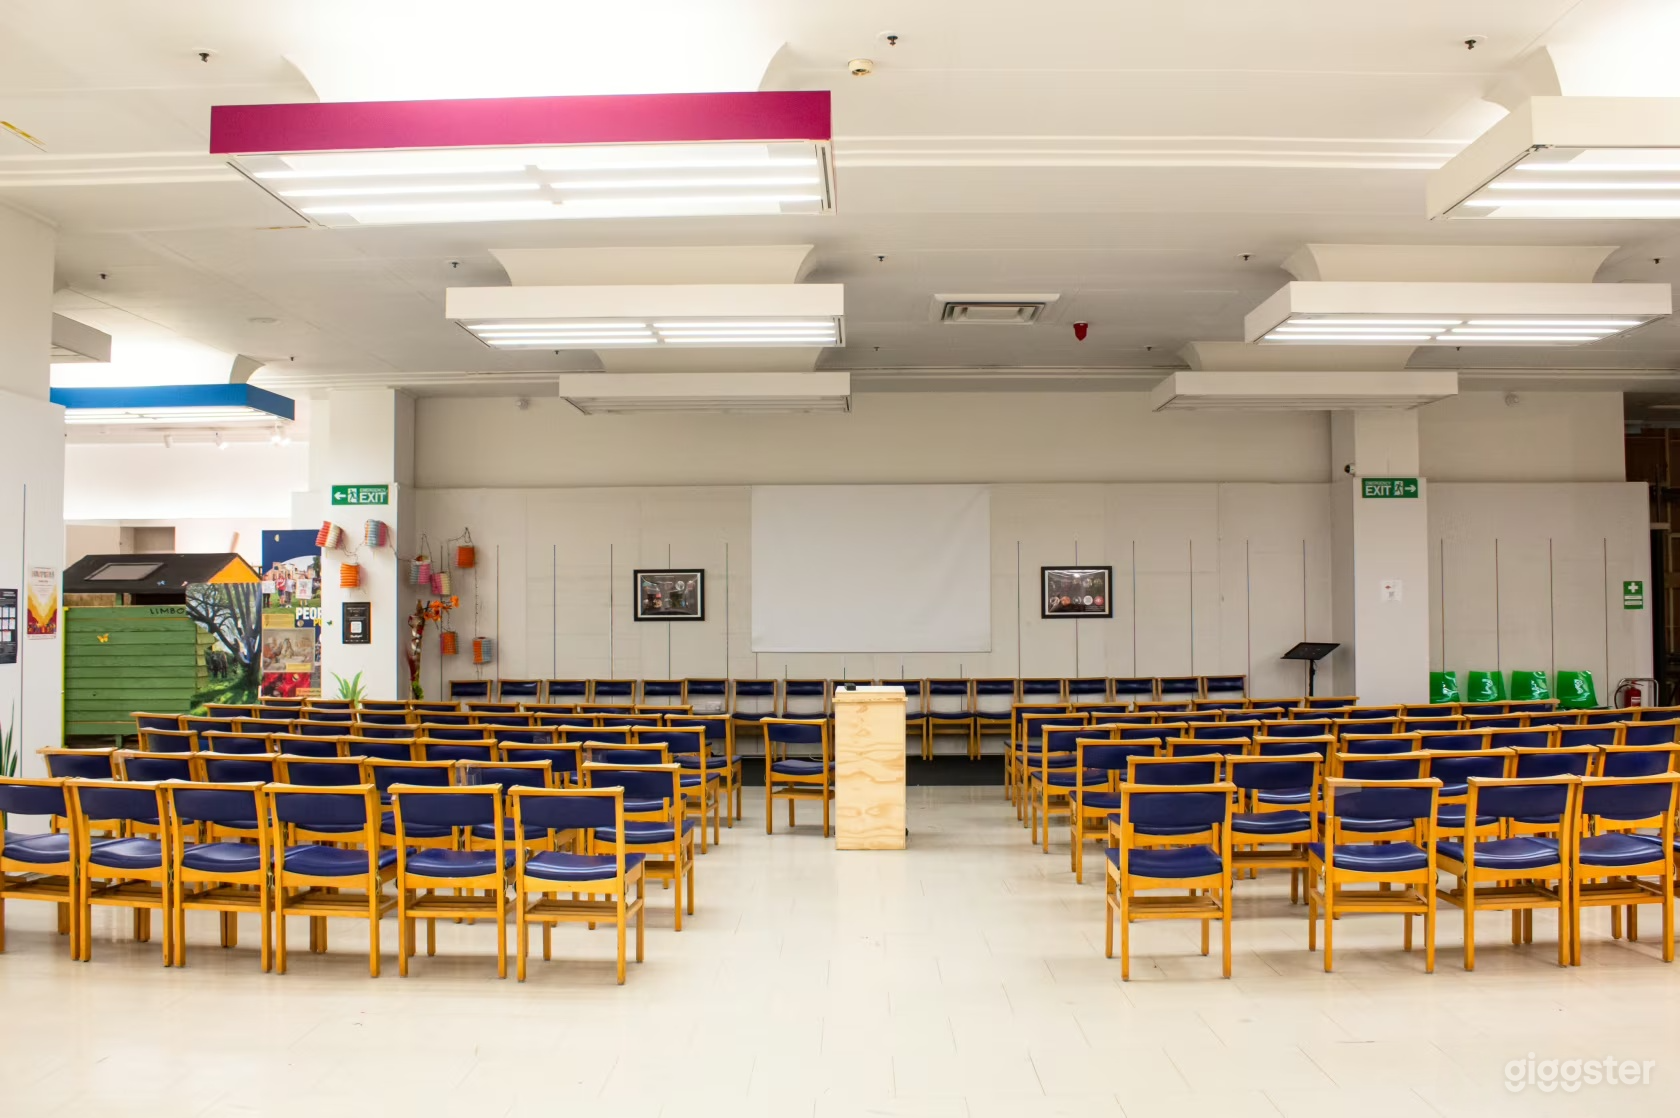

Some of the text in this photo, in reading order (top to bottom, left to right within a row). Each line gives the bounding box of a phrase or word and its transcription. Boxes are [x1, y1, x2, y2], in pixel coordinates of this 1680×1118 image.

[1365, 485, 1392, 496] EXIT
[359, 492, 387, 503] EXIT
[149, 607, 185, 615] LIMBO
